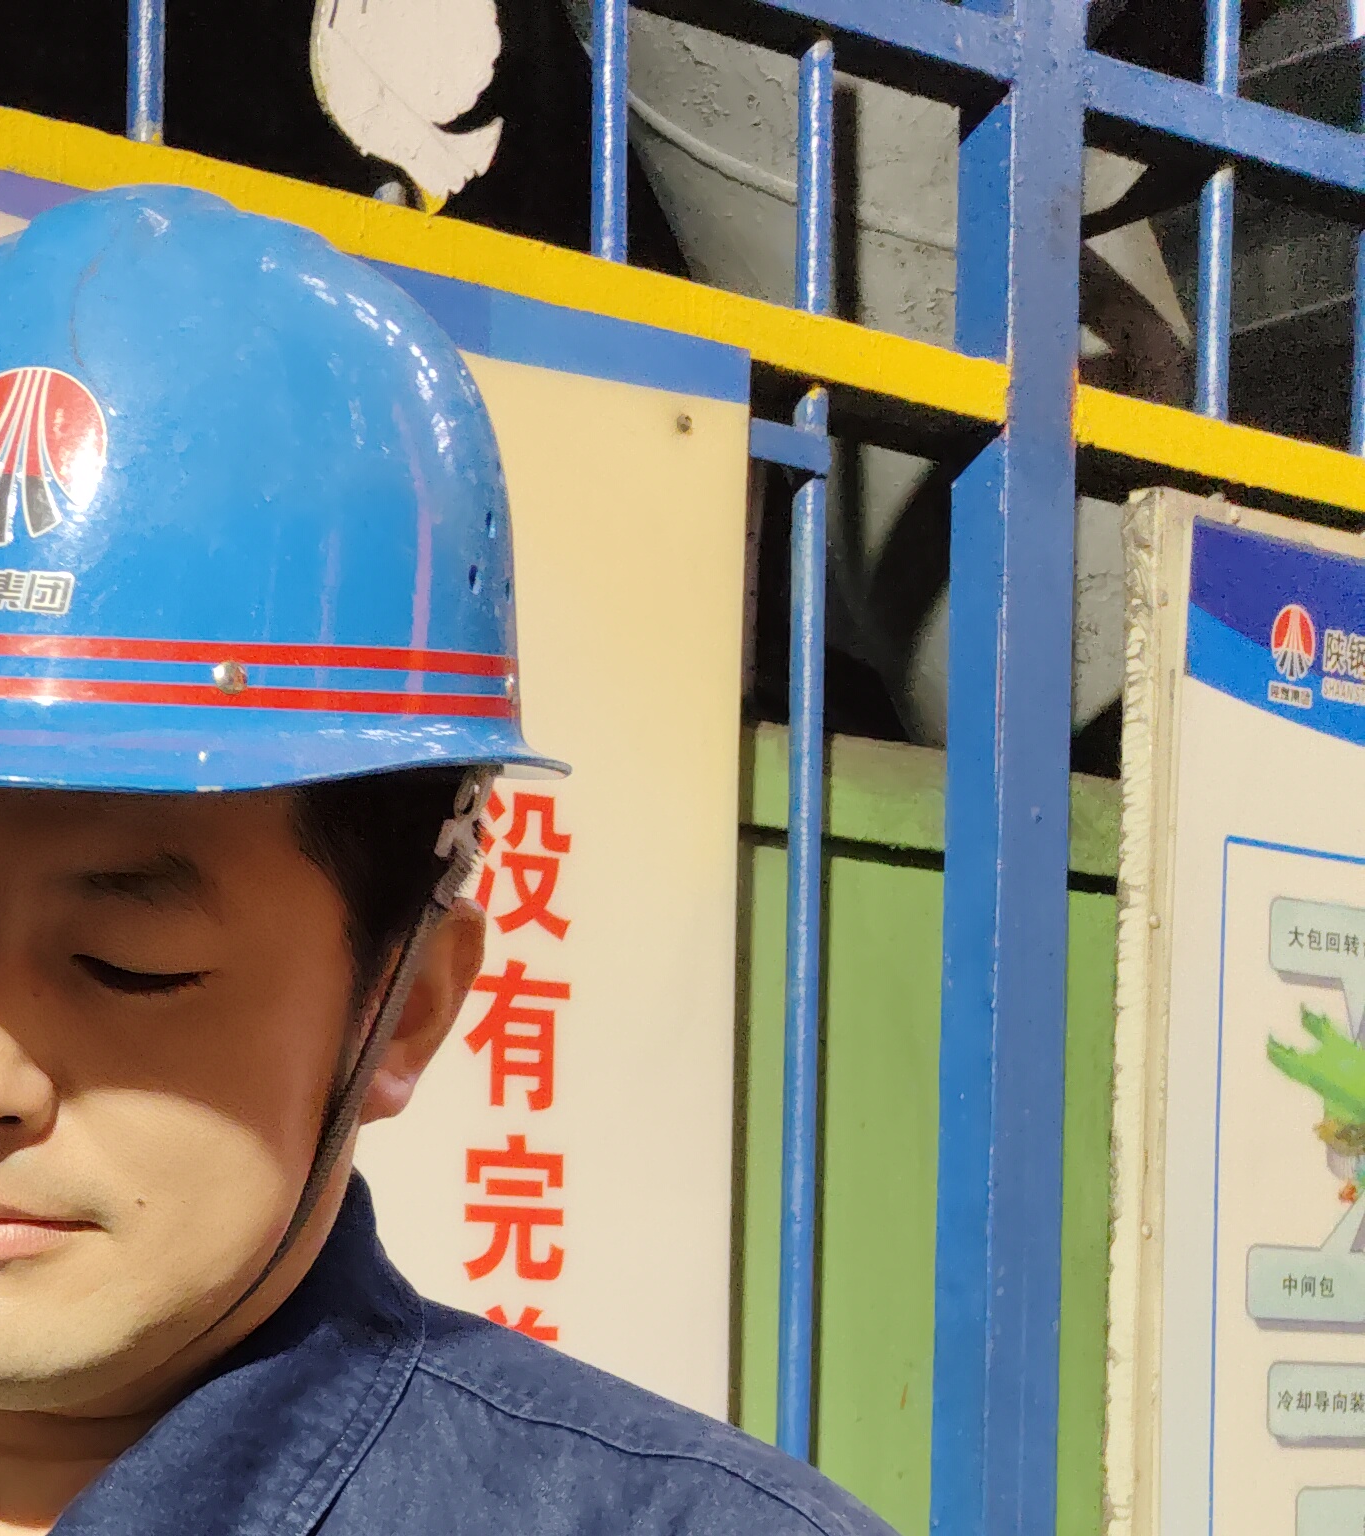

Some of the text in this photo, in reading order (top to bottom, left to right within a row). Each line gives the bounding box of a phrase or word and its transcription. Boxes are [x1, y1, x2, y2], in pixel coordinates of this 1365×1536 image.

[1288, 925, 1365, 957] 大包回转
[1282, 1274, 1335, 1298] 中间包
